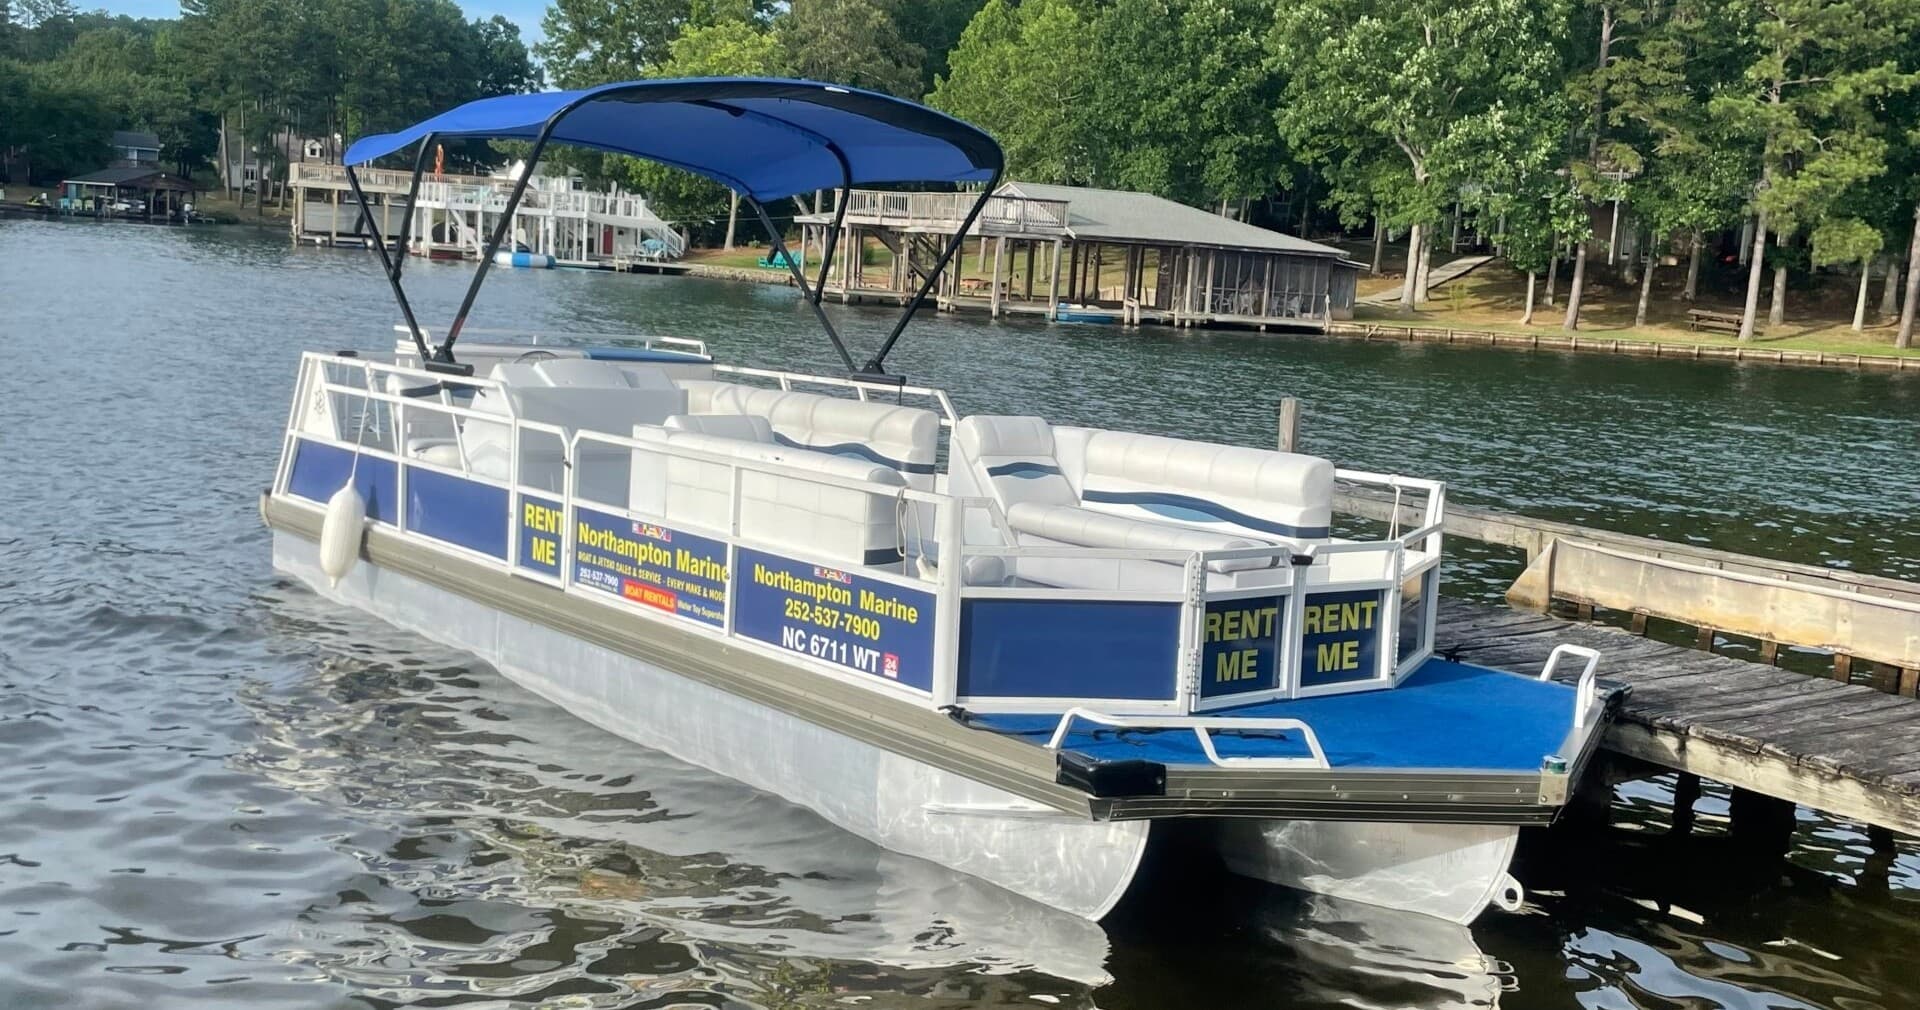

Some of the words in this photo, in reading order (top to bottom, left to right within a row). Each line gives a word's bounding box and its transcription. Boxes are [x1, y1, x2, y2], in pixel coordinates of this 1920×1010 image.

[524, 503, 564, 536] RENT
[532, 537, 556, 566] ME
[578, 522, 672, 568] Northampton
[676, 549, 729, 583] Marine
[578, 551, 592, 563] BOAT
[616, 561, 632, 576] SALES
[633, 566, 637, 577] &
[639, 568, 662, 585] SERVICE
[667, 576, 685, 592] EVERY
[685, 581, 702, 597] MAKE
[702, 587, 708, 598] &
[579, 567, 619, 587] 252-537-7900
[624, 583, 643, 598] BOAT
[643, 589, 675, 609] RENTALS
[754, 563, 852, 606] Northampton
[859, 589, 919, 624] Marine
[785, 598, 881, 641] 252-537-7900
[1203, 607, 1278, 643] RENT
[1303, 600, 1378, 635] RENT
[782, 626, 806, 652] NC
[810, 634, 847, 664] 6711
[853, 645, 881, 673] WT
[1216, 648, 1259, 683] ME
[1316, 640, 1359, 674] ME
